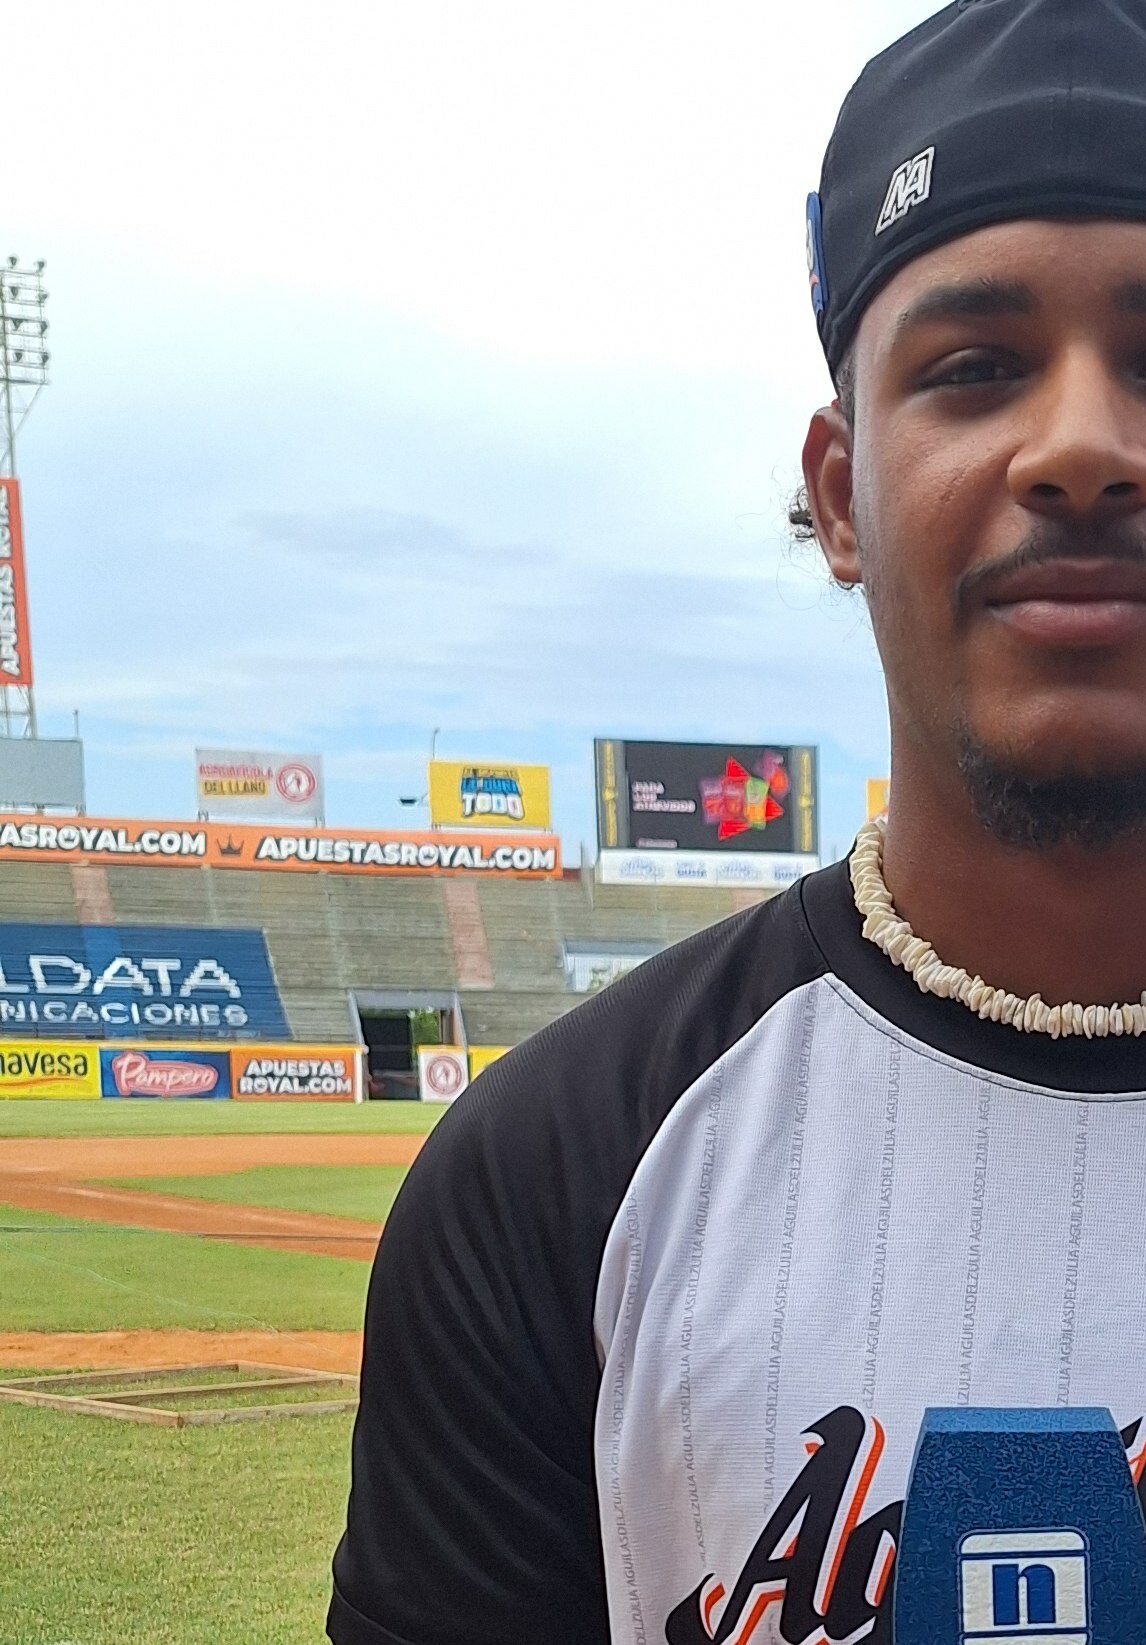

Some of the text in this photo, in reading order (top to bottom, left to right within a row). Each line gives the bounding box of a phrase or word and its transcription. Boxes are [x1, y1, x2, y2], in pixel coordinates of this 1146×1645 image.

[462, 792, 524, 819] TODO
[0, 822, 207, 856] ASROYAL.COM
[256, 835, 556, 870] APUESTASROYAL.COM
[117, 1053, 214, 1095] Pampero
[247, 1059, 345, 1077] APUESTAS
[239, 1076, 352, 1095] ROYAL.COM
[992, 1564, 1057, 1627] n
